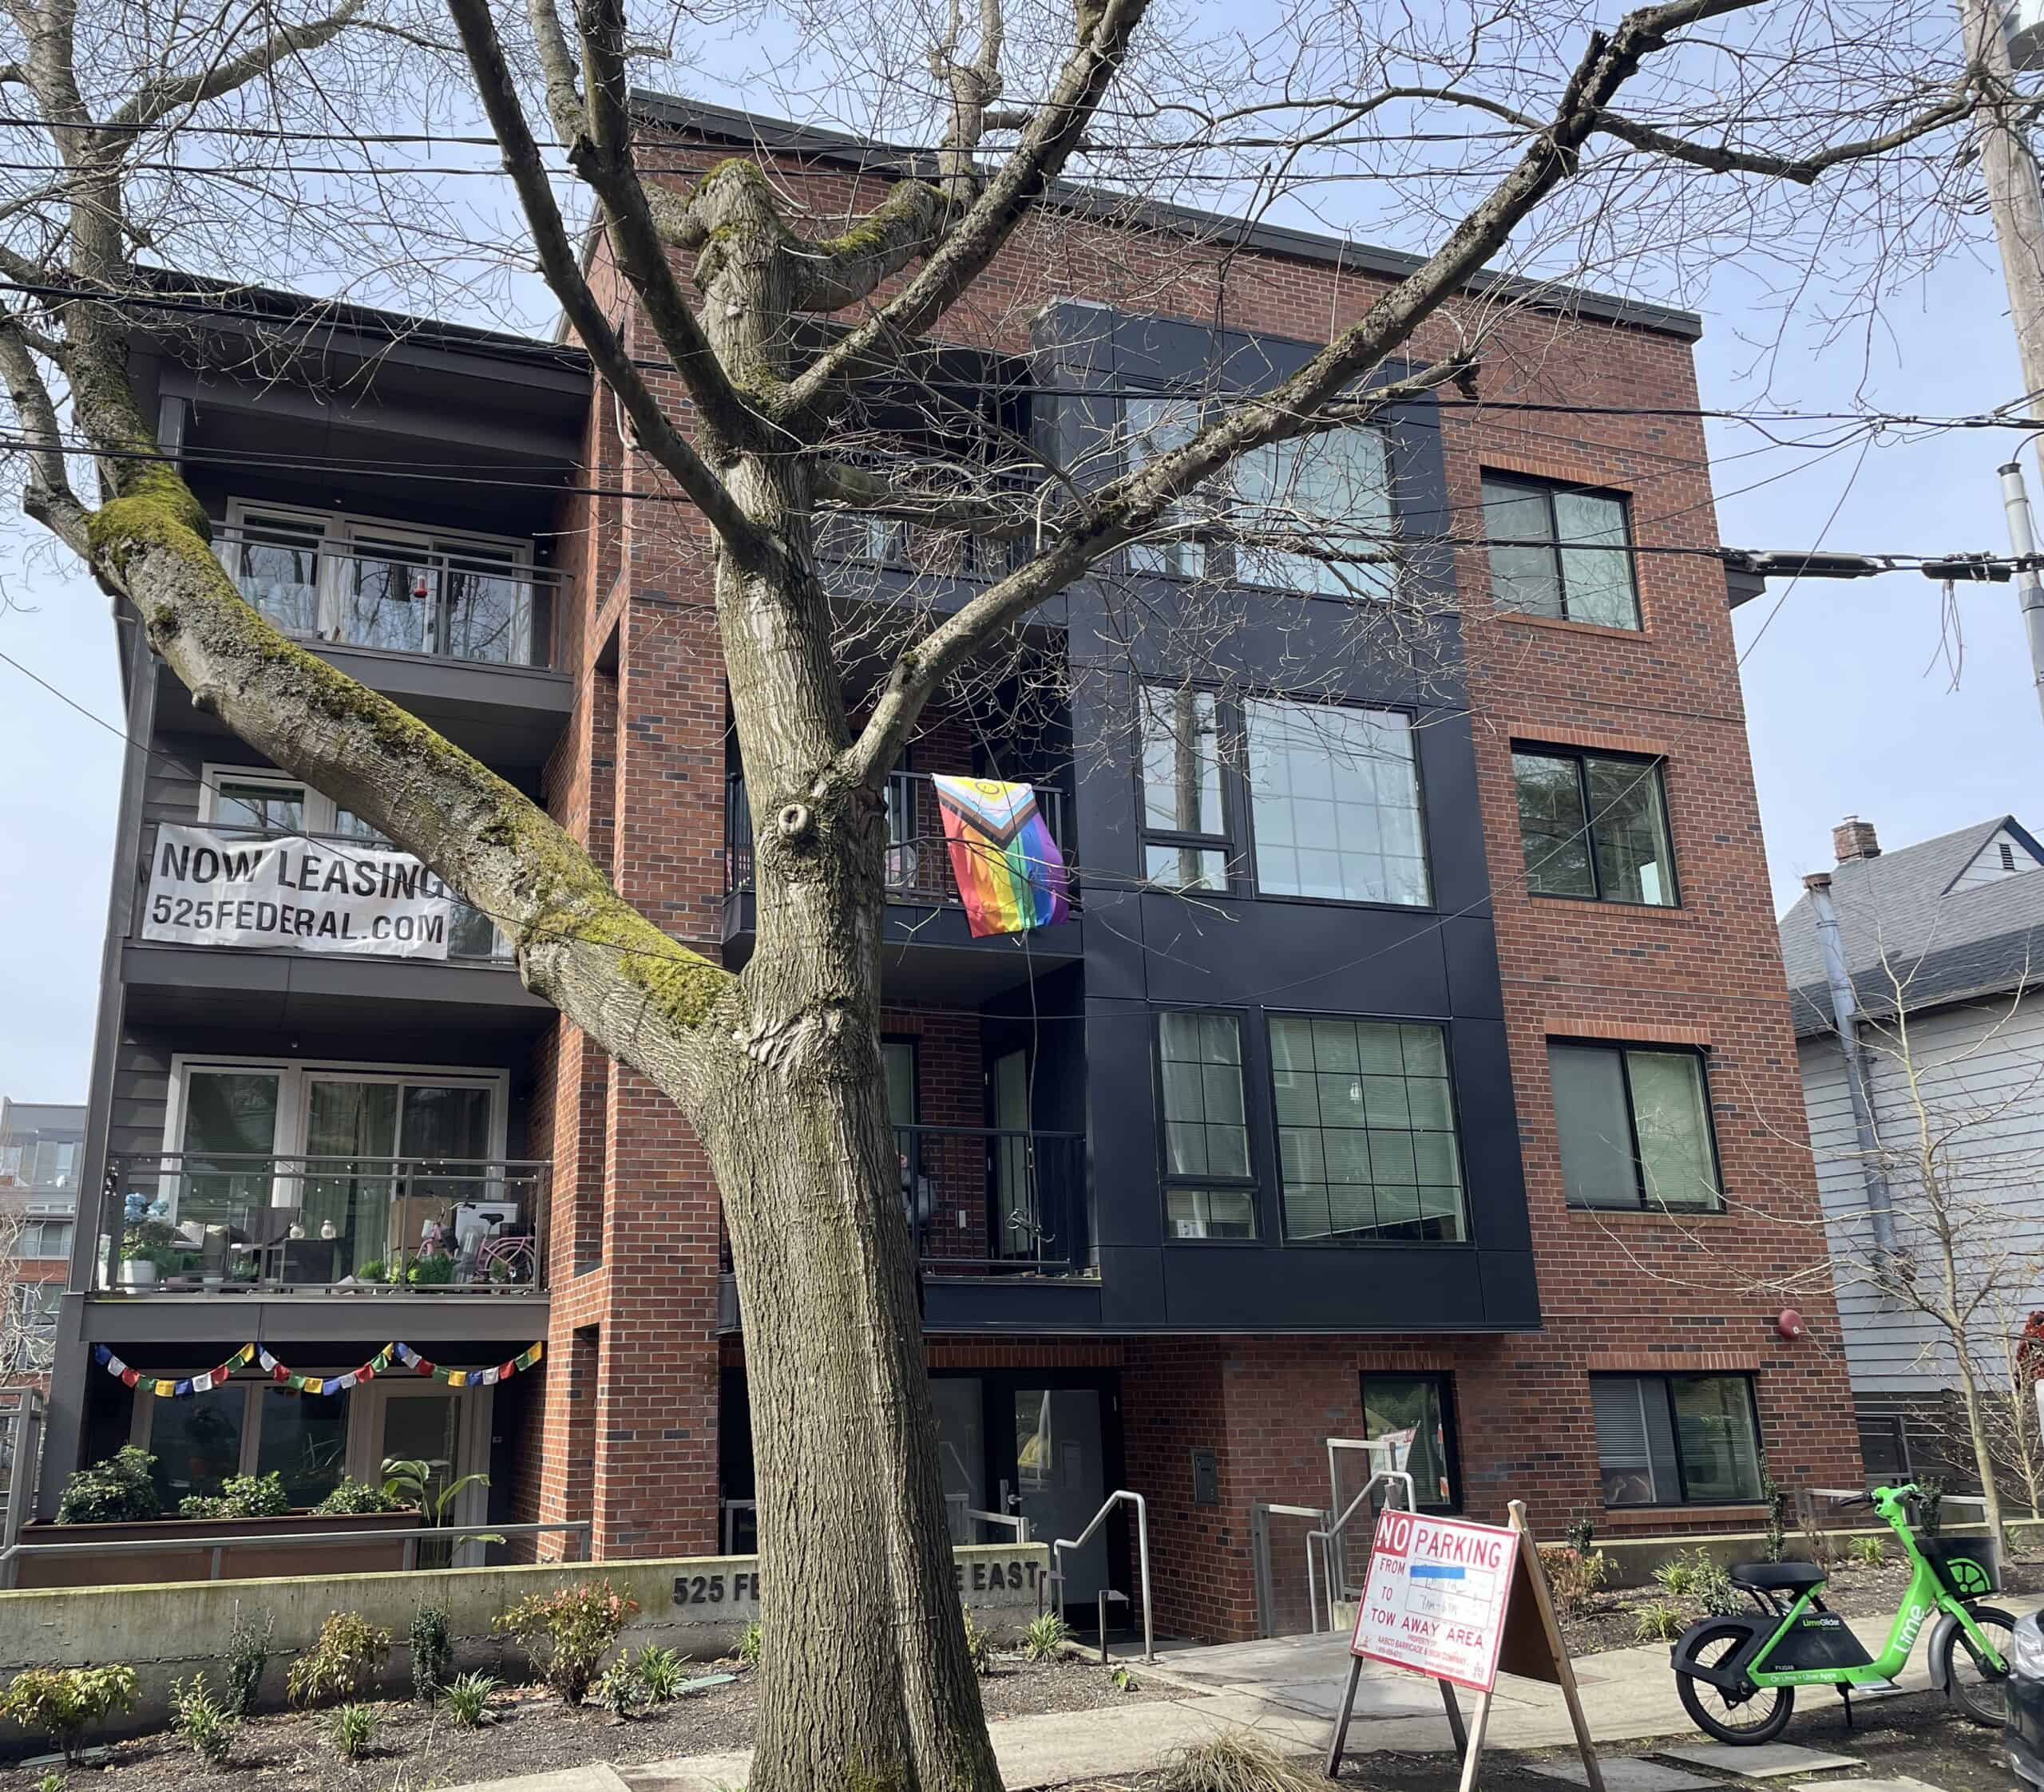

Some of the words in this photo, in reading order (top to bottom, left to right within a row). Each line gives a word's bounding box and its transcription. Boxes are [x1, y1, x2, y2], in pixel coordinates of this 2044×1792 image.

[161, 843, 263, 884] NOW
[278, 850, 444, 900] LEASING
[153, 894, 444, 943] 525FEDERAL.COM
[1377, 1517, 1409, 1551] NO
[1414, 1529, 1502, 1568] PARKING
[672, 1575, 723, 1604] 525
[972, 1561, 1039, 1590] EAST
[1380, 1558, 1406, 1576] FROM
[1382, 1586, 1393, 1601] TO
[1371, 1608, 1396, 1626] TOW
[1401, 1616, 1440, 1636] AWAY
[1446, 1628, 1483, 1649] AREA
[1892, 1605, 1925, 1653] Lime
